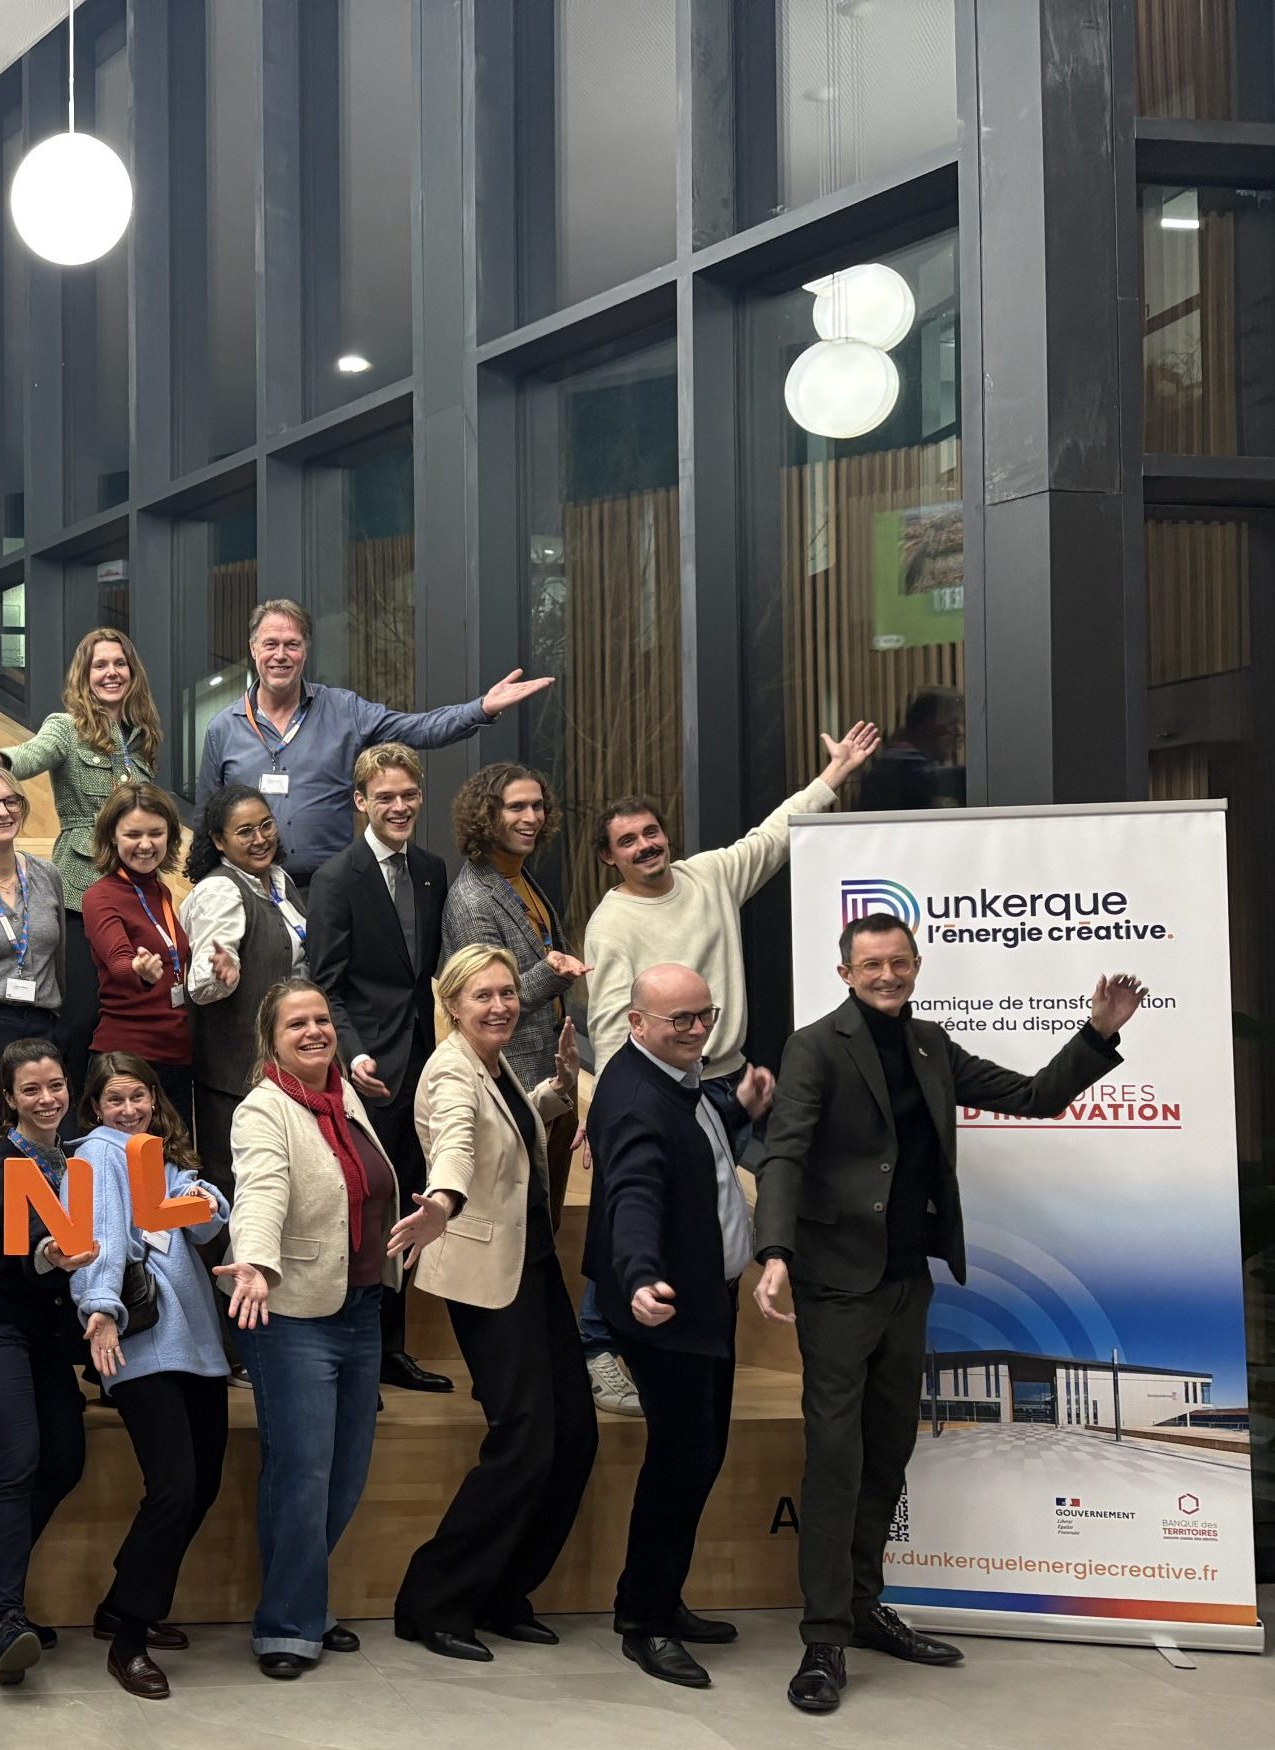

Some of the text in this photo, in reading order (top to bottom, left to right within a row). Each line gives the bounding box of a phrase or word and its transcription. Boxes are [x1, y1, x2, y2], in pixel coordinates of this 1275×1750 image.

[999, 996, 1023, 1010] de
[992, 1016, 1017, 1031] du
[1055, 1509, 1136, 1520] GOUVERNEMENT
[1162, 1519, 1218, 1529] BANQUE des
